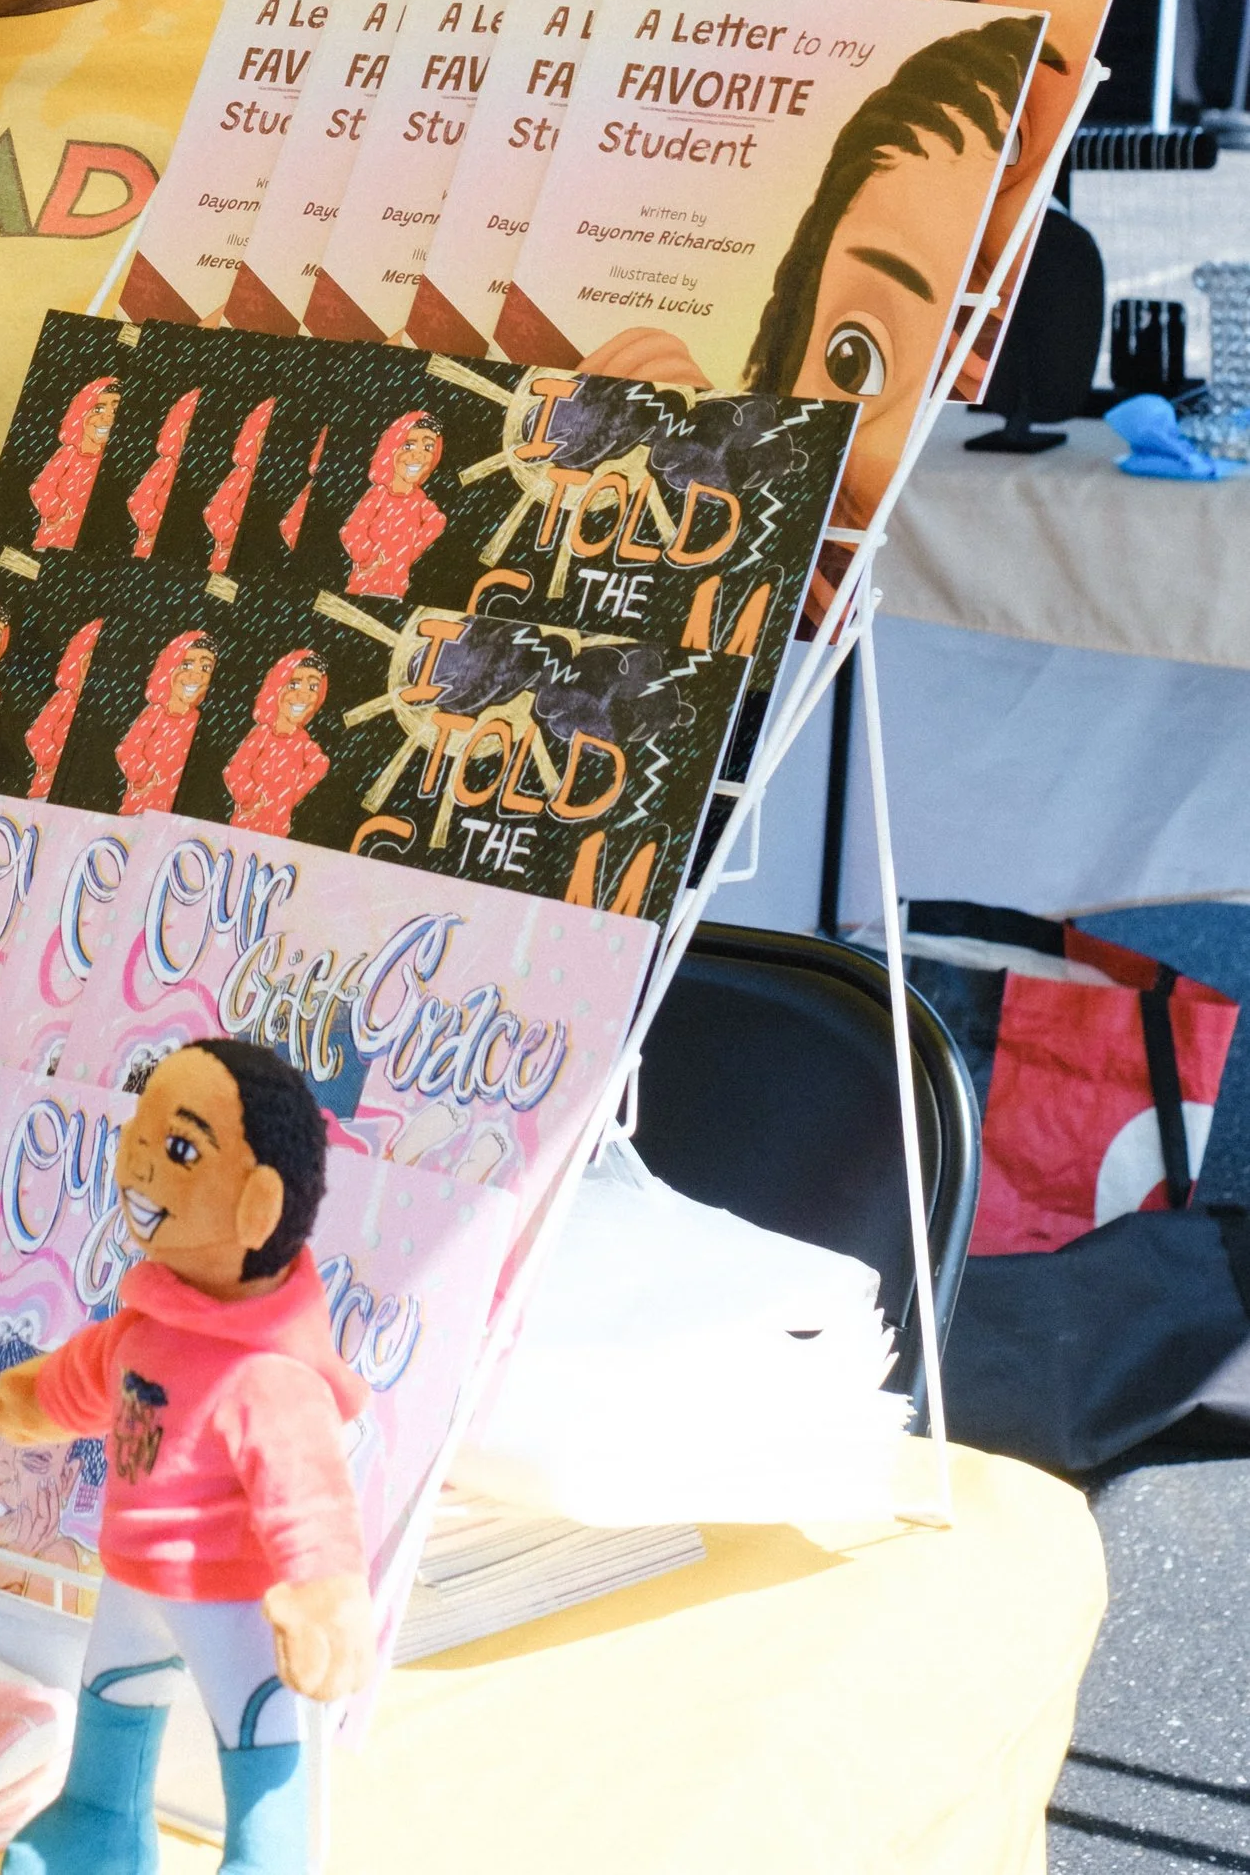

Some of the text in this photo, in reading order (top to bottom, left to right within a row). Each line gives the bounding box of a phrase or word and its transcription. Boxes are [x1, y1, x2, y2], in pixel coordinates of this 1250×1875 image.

[635, 9, 876, 67] A Letter to my
[617, 63, 814, 116] FAVORITE
[598, 121, 757, 169] Student
[576, 220, 756, 255] Dayonne Richardson
[640, 205, 707, 227] Written by
[577, 286, 714, 316] Meredith Lucius
[609, 265, 698, 291] Illustrated by
[513, 377, 582, 462] I
[535, 467, 742, 567] TOLD
[578, 569, 655, 619] THE
[400, 619, 468, 705] I
[419, 712, 628, 822] TOLD
[461, 817, 538, 873] THE
[145, 836, 296, 985] Our
[218, 912, 567, 1112] Gift Grace
